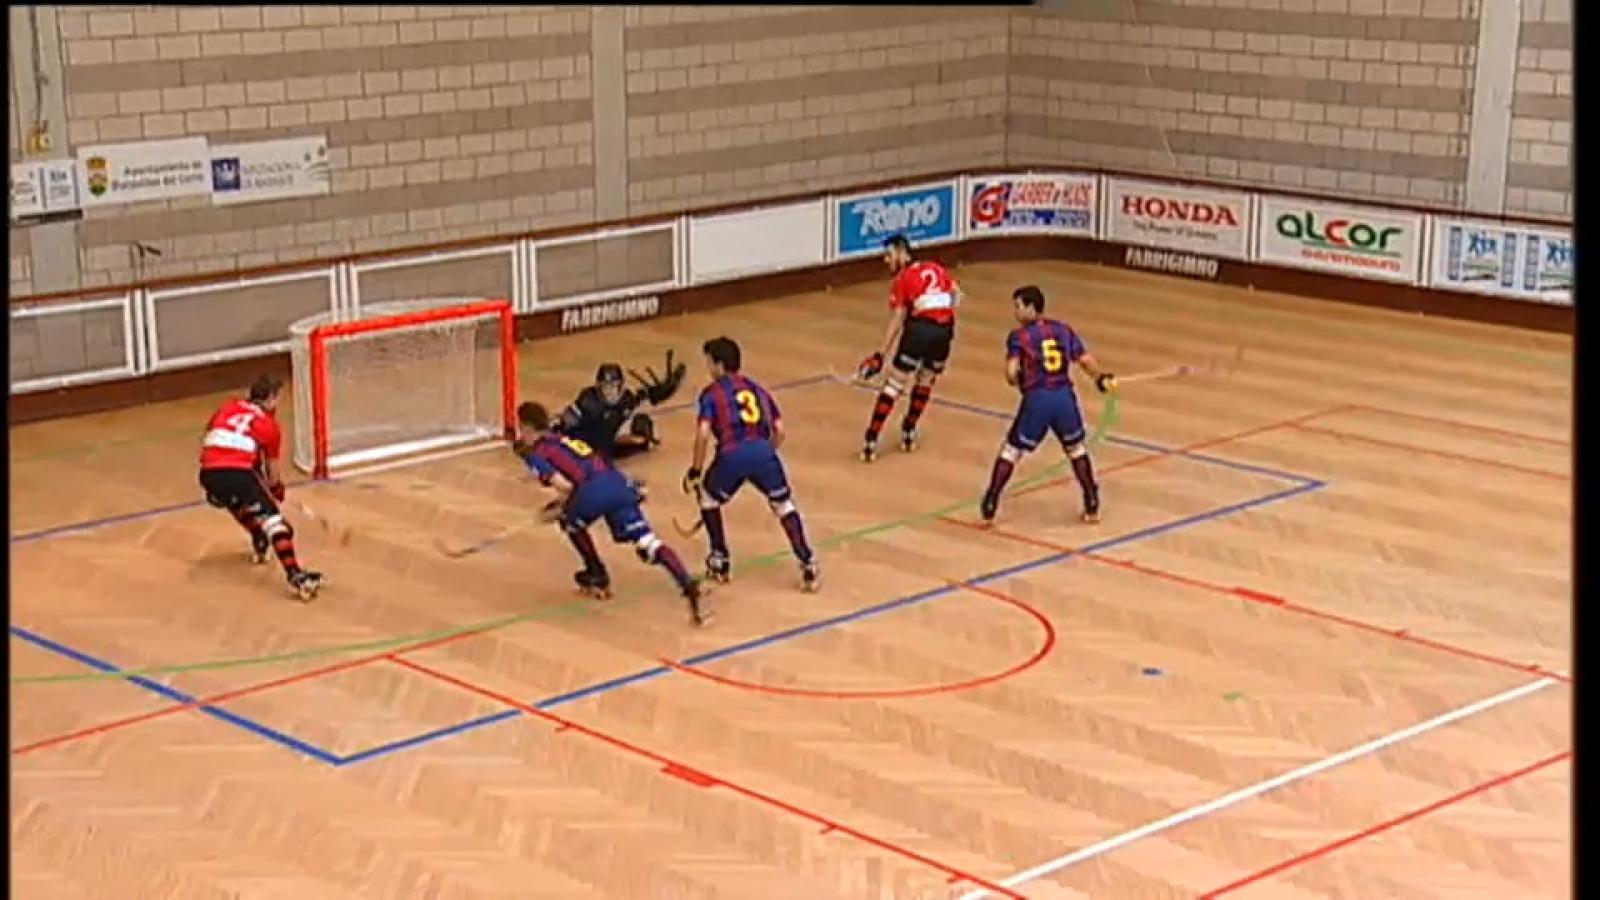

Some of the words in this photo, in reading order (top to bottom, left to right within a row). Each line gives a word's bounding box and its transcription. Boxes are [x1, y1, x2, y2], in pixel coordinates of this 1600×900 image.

[1121, 194, 1238, 226] HONDA
[920, 269, 941, 294] 2
[1041, 338, 1062, 372] 5
[736, 389, 762, 424] 3
[227, 412, 254, 434] 4
